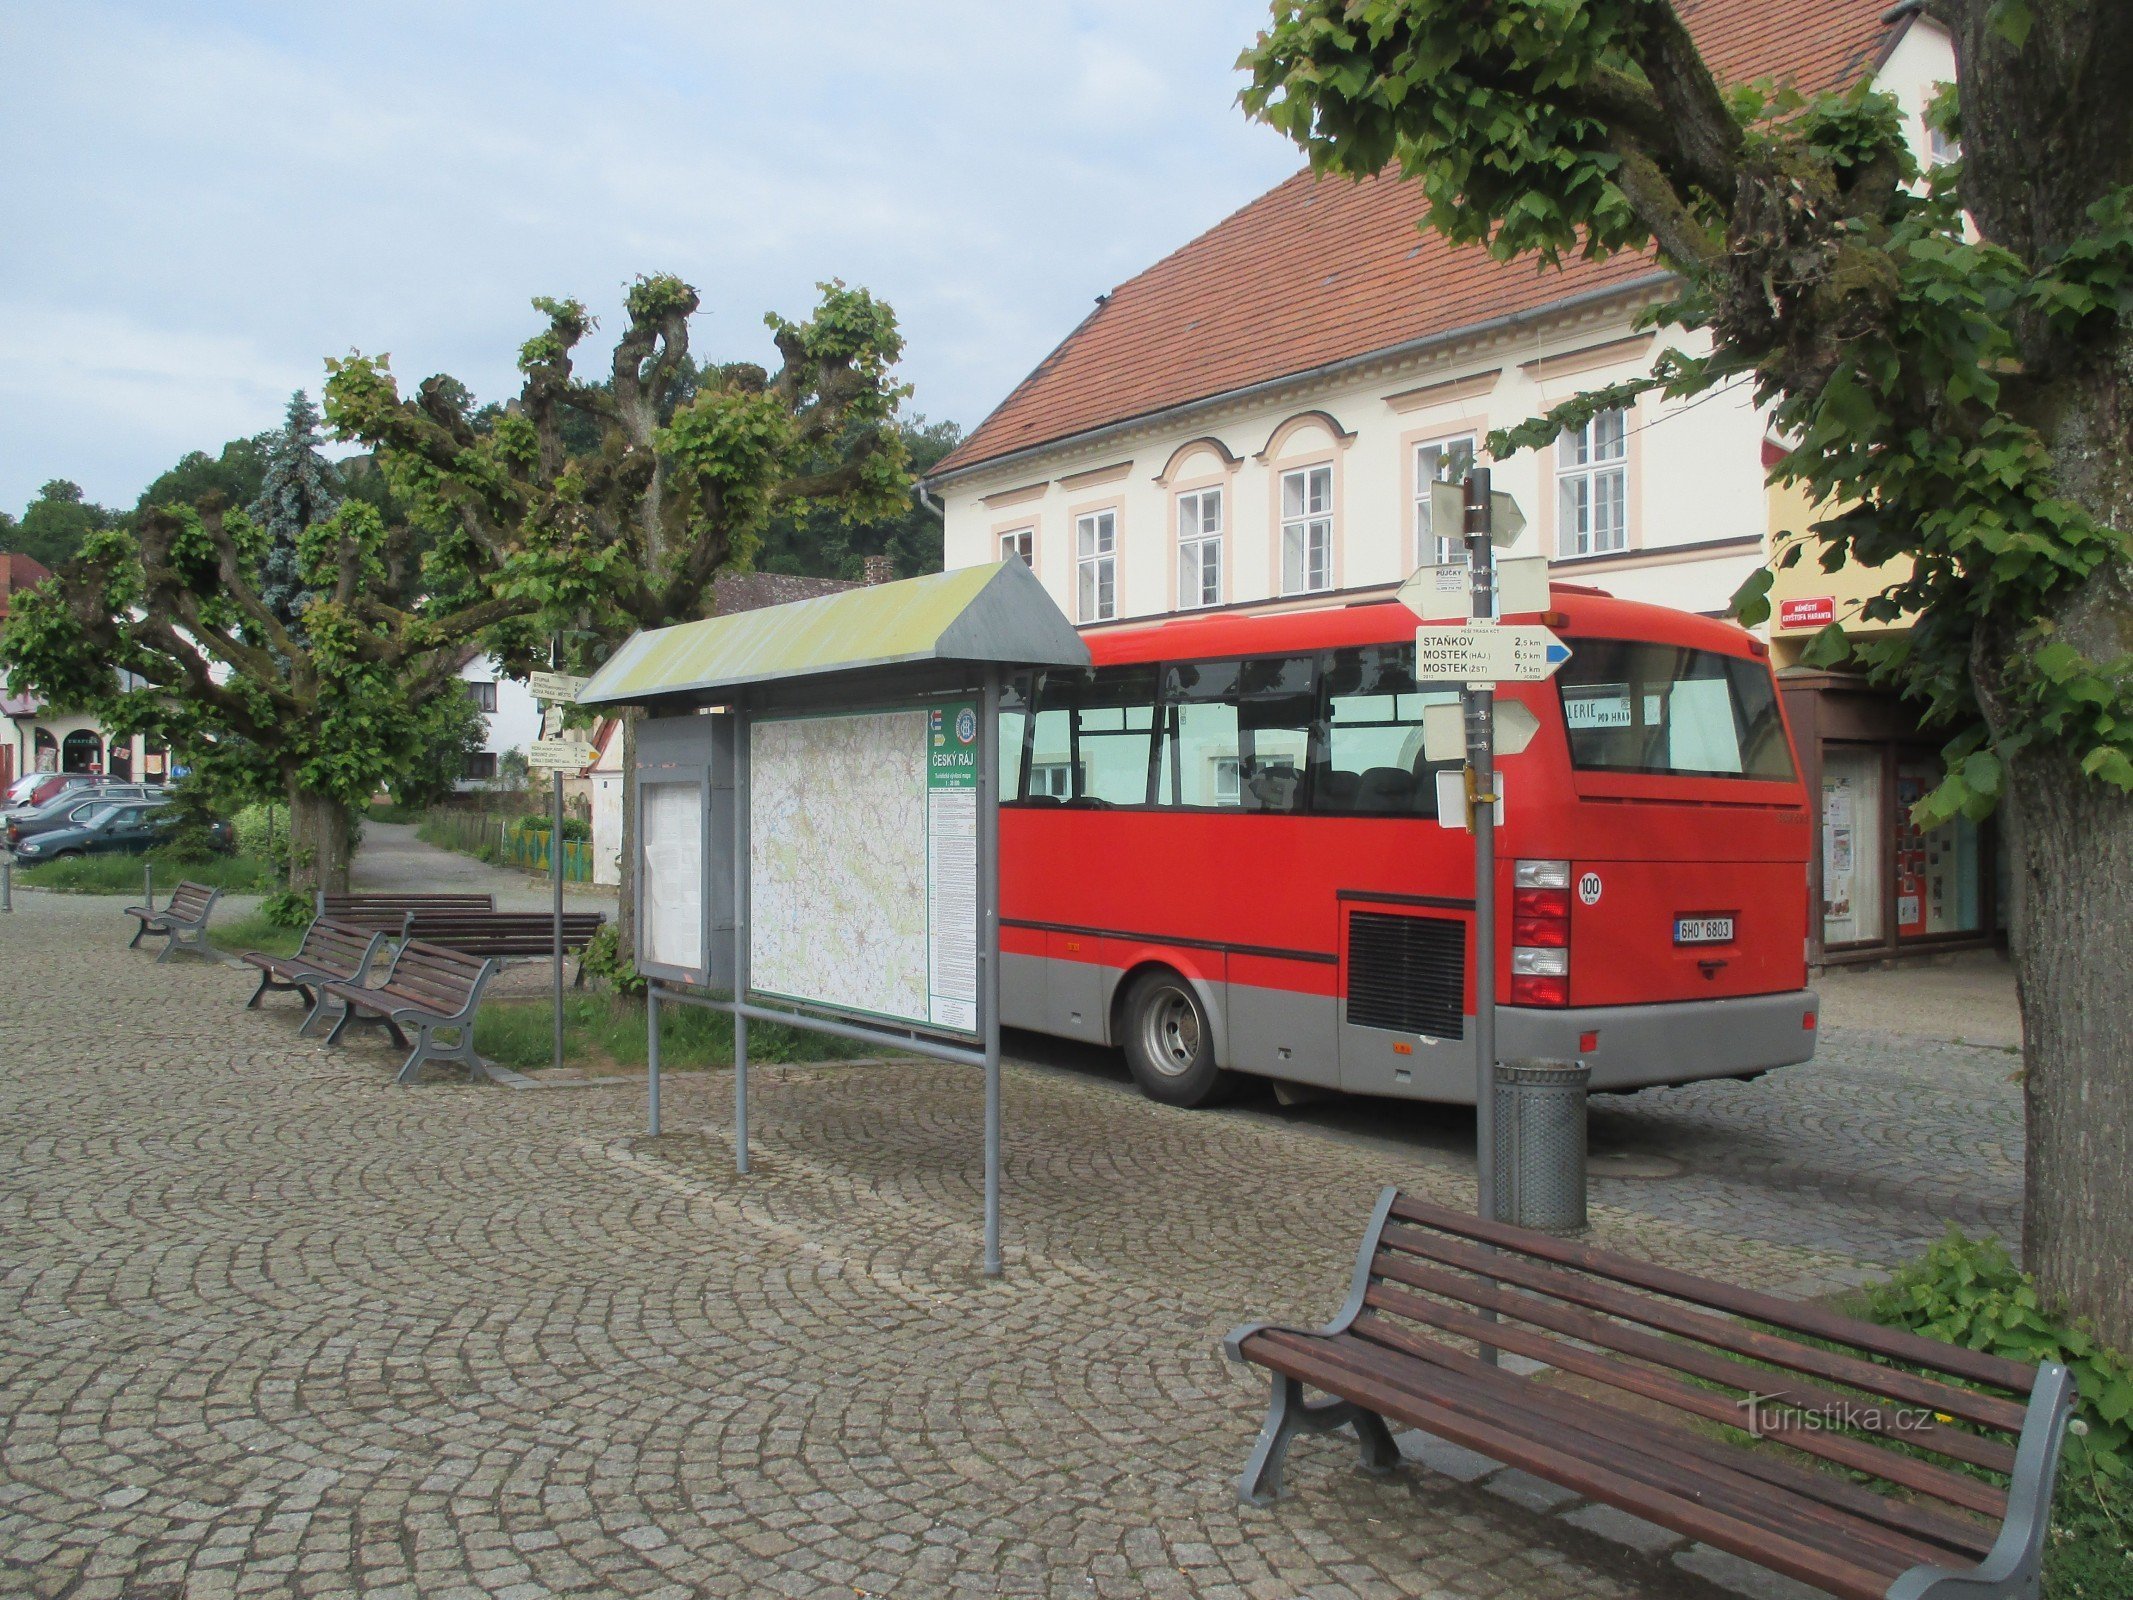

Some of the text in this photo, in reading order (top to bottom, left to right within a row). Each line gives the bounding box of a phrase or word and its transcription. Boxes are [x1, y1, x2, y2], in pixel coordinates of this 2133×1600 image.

[1807, 612, 1831, 620] HARANTA
[1424, 635, 1474, 646] STAŇKOV
[1514, 637, 1528, 647] 2,5
[1423, 650, 1468, 660] MOSTEK
[1514, 650, 1528, 660] 6,5
[1423, 663, 1468, 673] MOSTEK
[1514, 663, 1528, 673] 7,5
[933, 751, 974, 767] ČESKÝ RÁJ
[1582, 878, 1599, 895] 100
[1706, 921, 1729, 937] 6803
